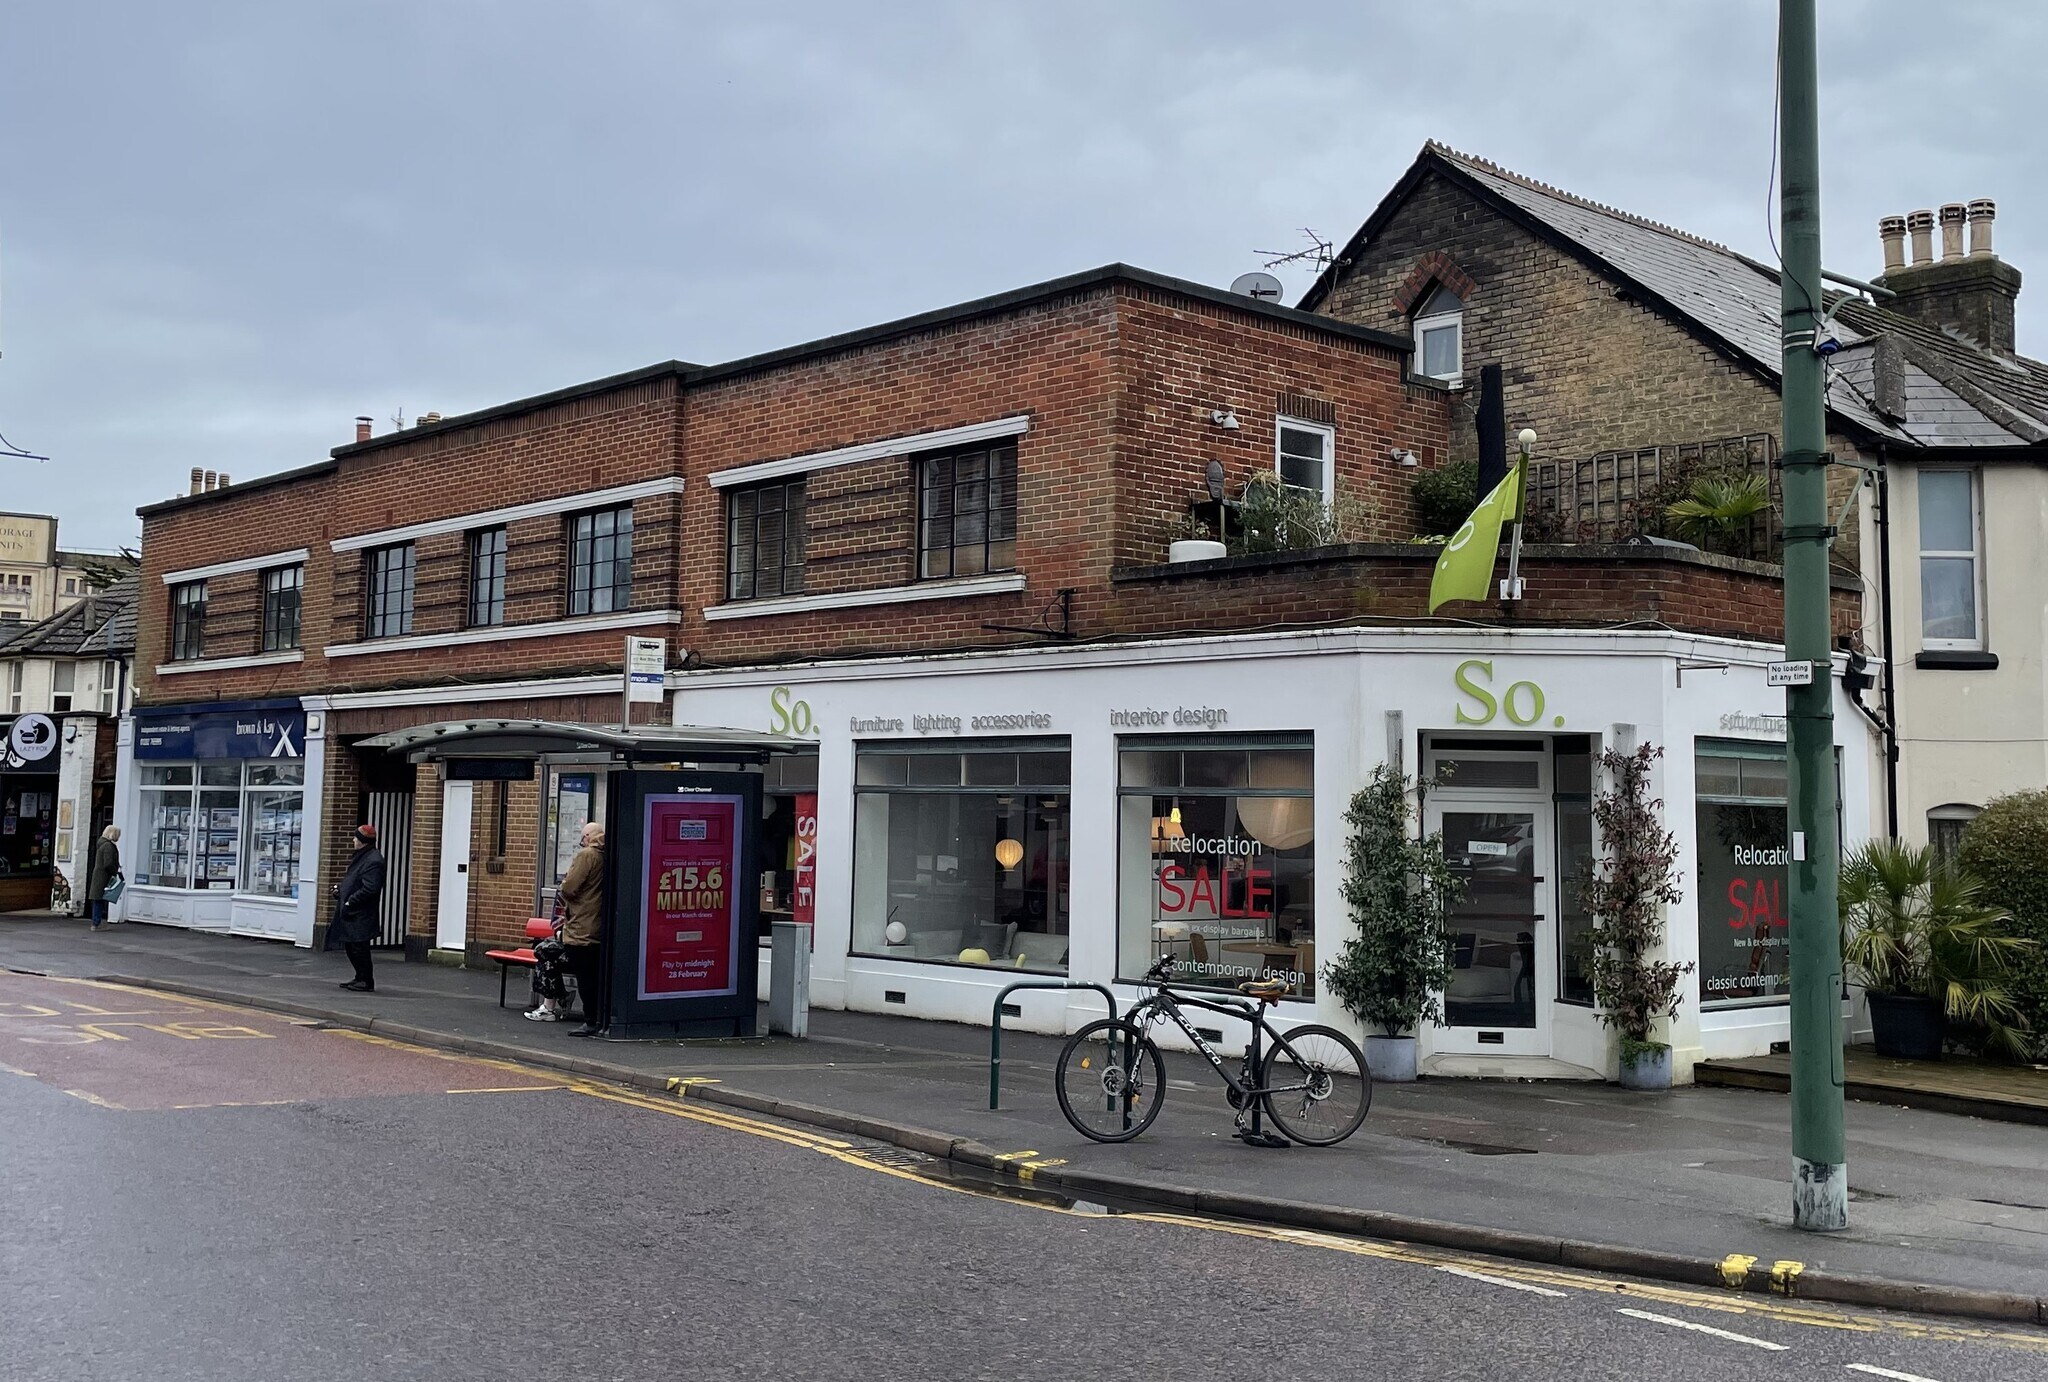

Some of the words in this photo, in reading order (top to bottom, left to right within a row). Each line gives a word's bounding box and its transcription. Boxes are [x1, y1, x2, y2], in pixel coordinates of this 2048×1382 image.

[1780, 674, 1791, 682] any
[1783, 664, 1809, 672] loading
[1455, 660, 1565, 727] So.
[770, 686, 820, 735] So.
[1110, 707, 1169, 727] interior
[1172, 705, 1228, 729] design
[236, 720, 256, 735] brown
[256, 720, 262, 734] &
[263, 718, 276, 739] kay
[850, 716, 905, 733] furniture
[913, 714, 963, 735] lighting
[971, 711, 1052, 731] accessories
[1170, 833, 1262, 856] Relocation
[1477, 844, 1499, 852] OPEN
[796, 816, 817, 907] SALE
[659, 867, 723, 890] £15.6
[656, 891, 725, 911] MILLION
[1160, 865, 1273, 919] SALE
[1728, 878, 1788, 929] SAL
[1734, 938, 1746, 947] New
[1747, 937, 1752, 947] &
[1753, 936, 1780, 947] ex-display
[662, 961, 674, 969] Play
[676, 961, 684, 969] by
[685, 960, 715, 968] midnight
[678, 970, 708, 978] February
[1171, 959, 1258, 981] contemporary
[1262, 965, 1306, 985] design
[1707, 975, 1738, 991] classic
[1177, 1015, 1222, 1065] carrera
